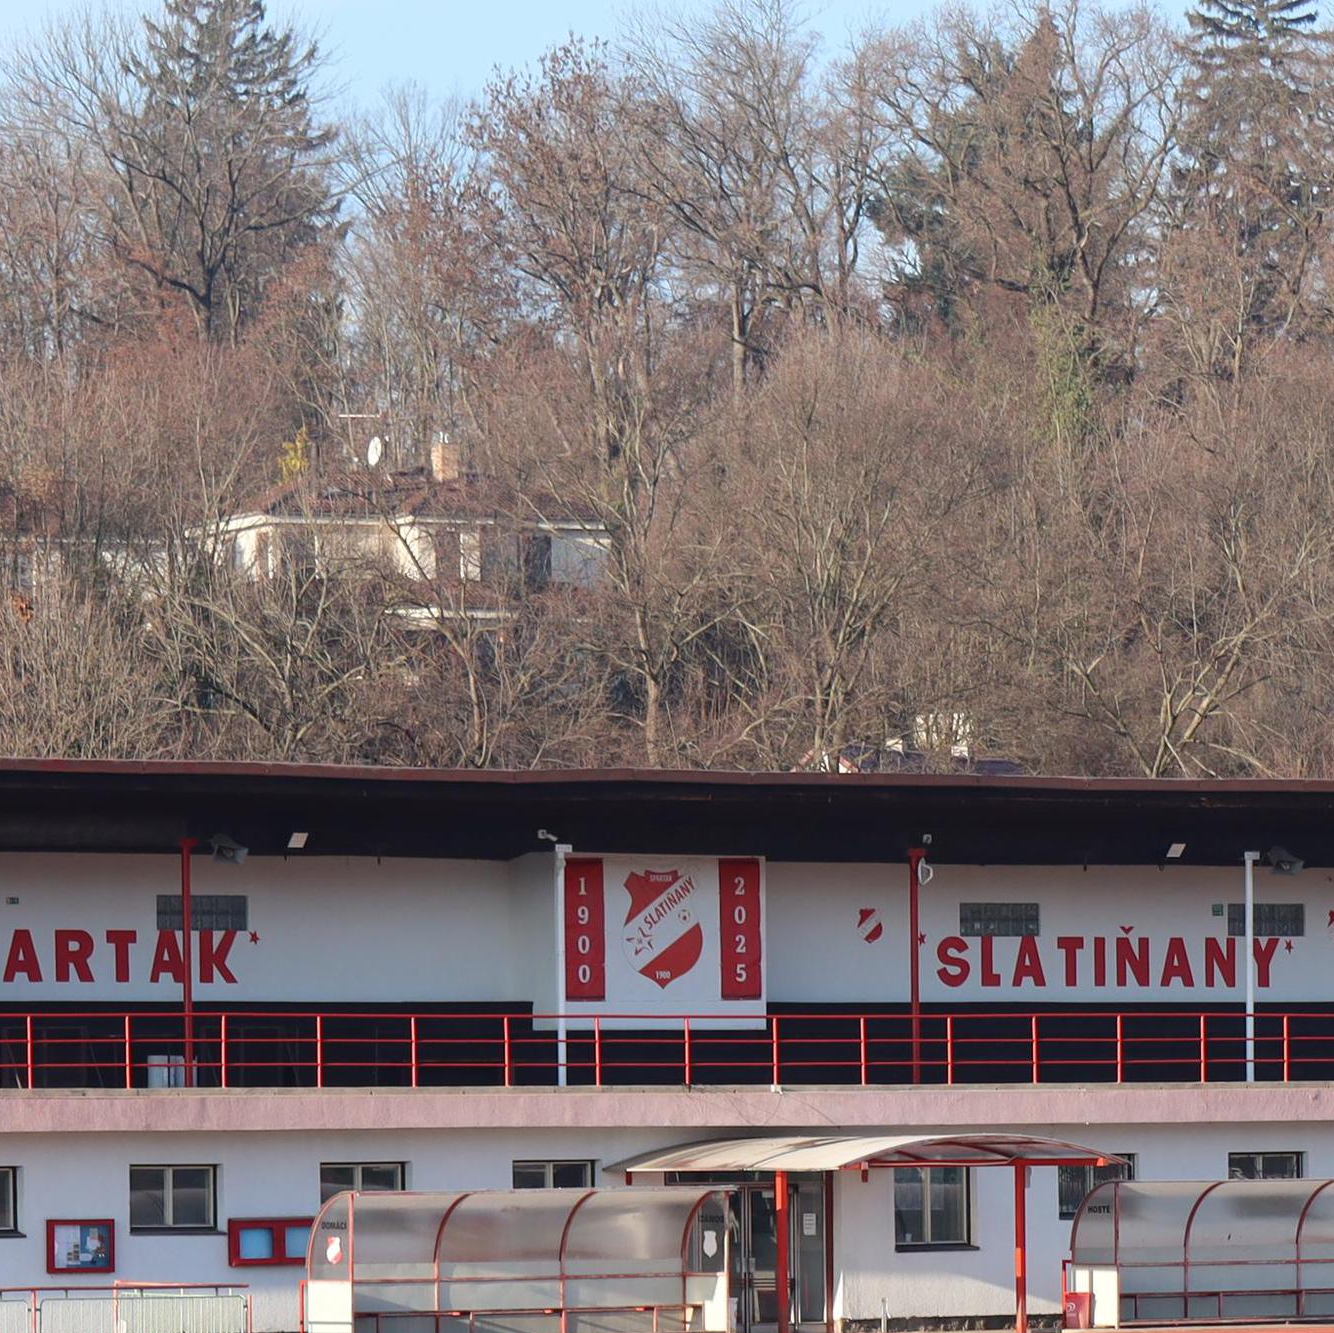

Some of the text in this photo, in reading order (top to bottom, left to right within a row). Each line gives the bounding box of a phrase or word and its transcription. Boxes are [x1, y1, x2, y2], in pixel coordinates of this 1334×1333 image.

[577, 877, 591, 983] 1900
[644, 875, 695, 930] SLATIŇANY
[734, 877, 747, 982] 2025
[936, 925, 1280, 987] SLATIŇANY
